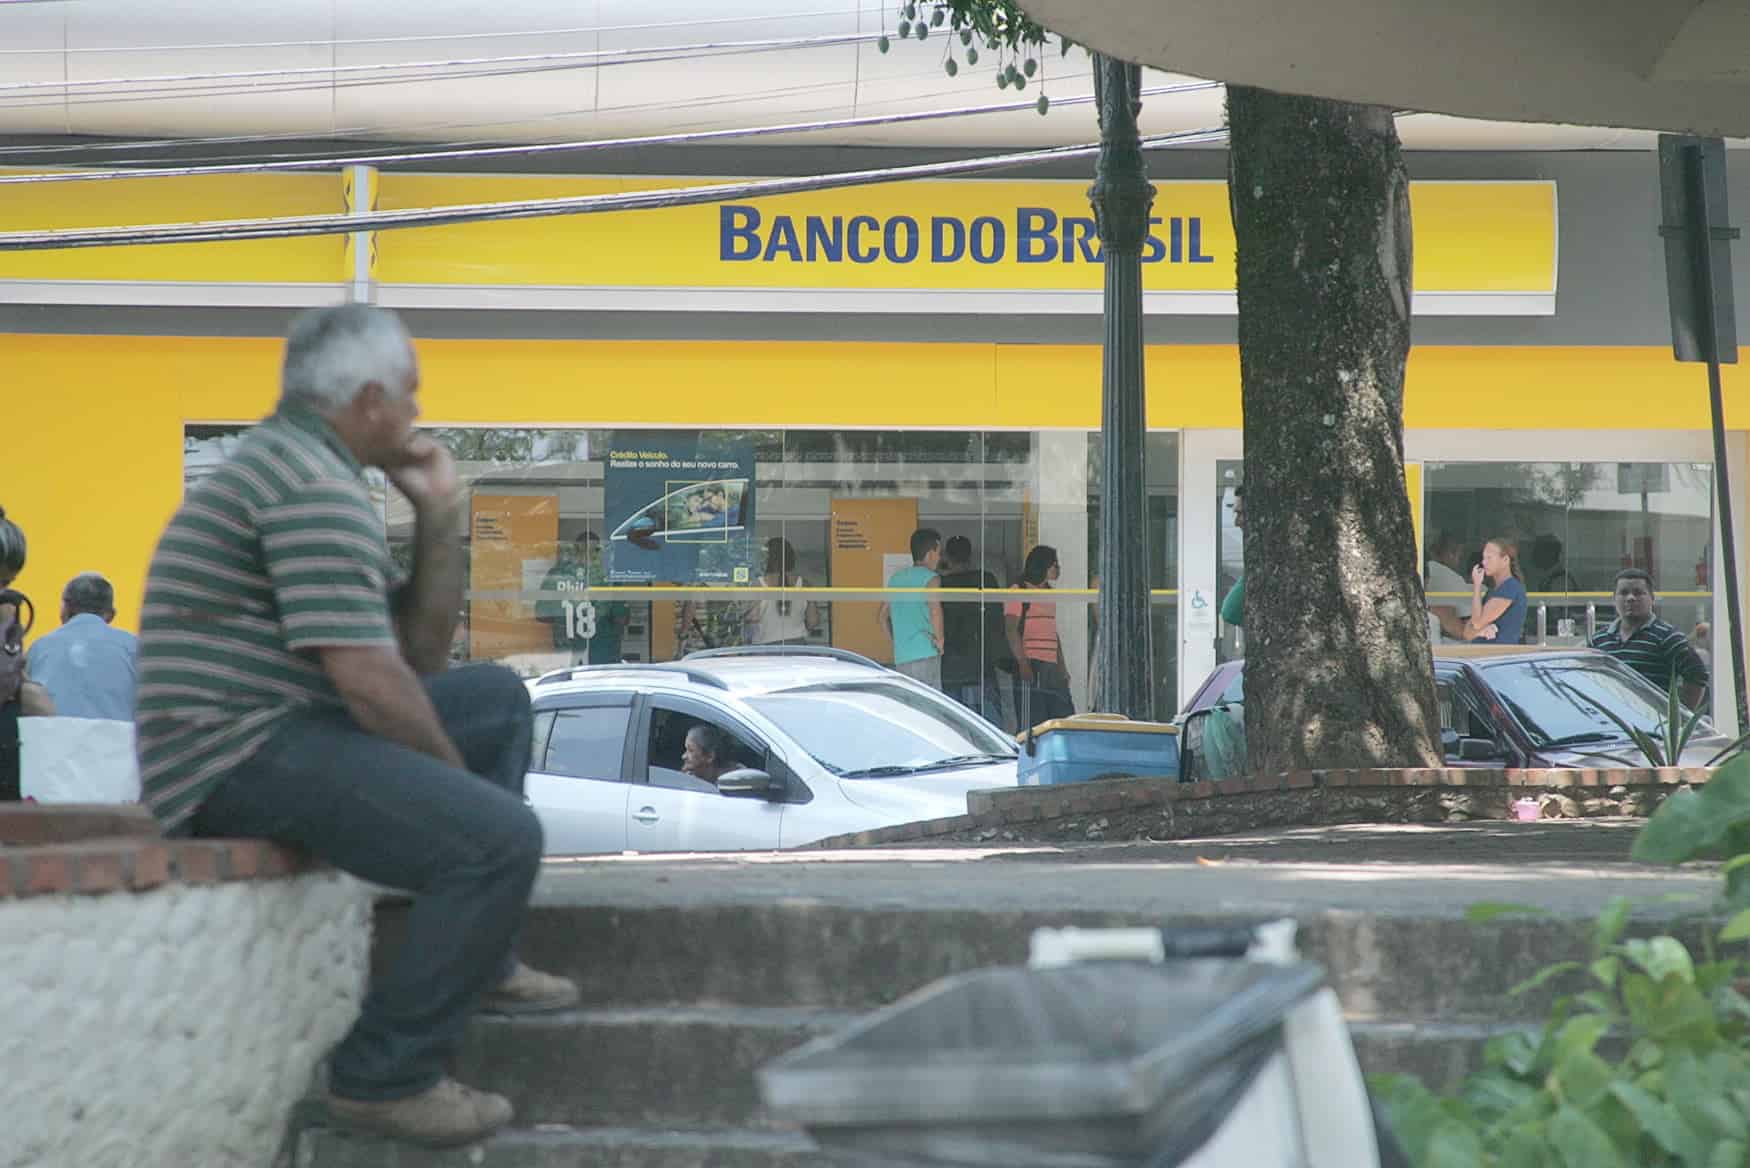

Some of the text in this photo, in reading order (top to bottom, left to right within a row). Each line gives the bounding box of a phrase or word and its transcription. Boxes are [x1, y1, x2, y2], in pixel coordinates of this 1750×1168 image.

[719, 205, 1215, 264] BANCO DO BRSIL
[561, 600, 597, 639] 18
